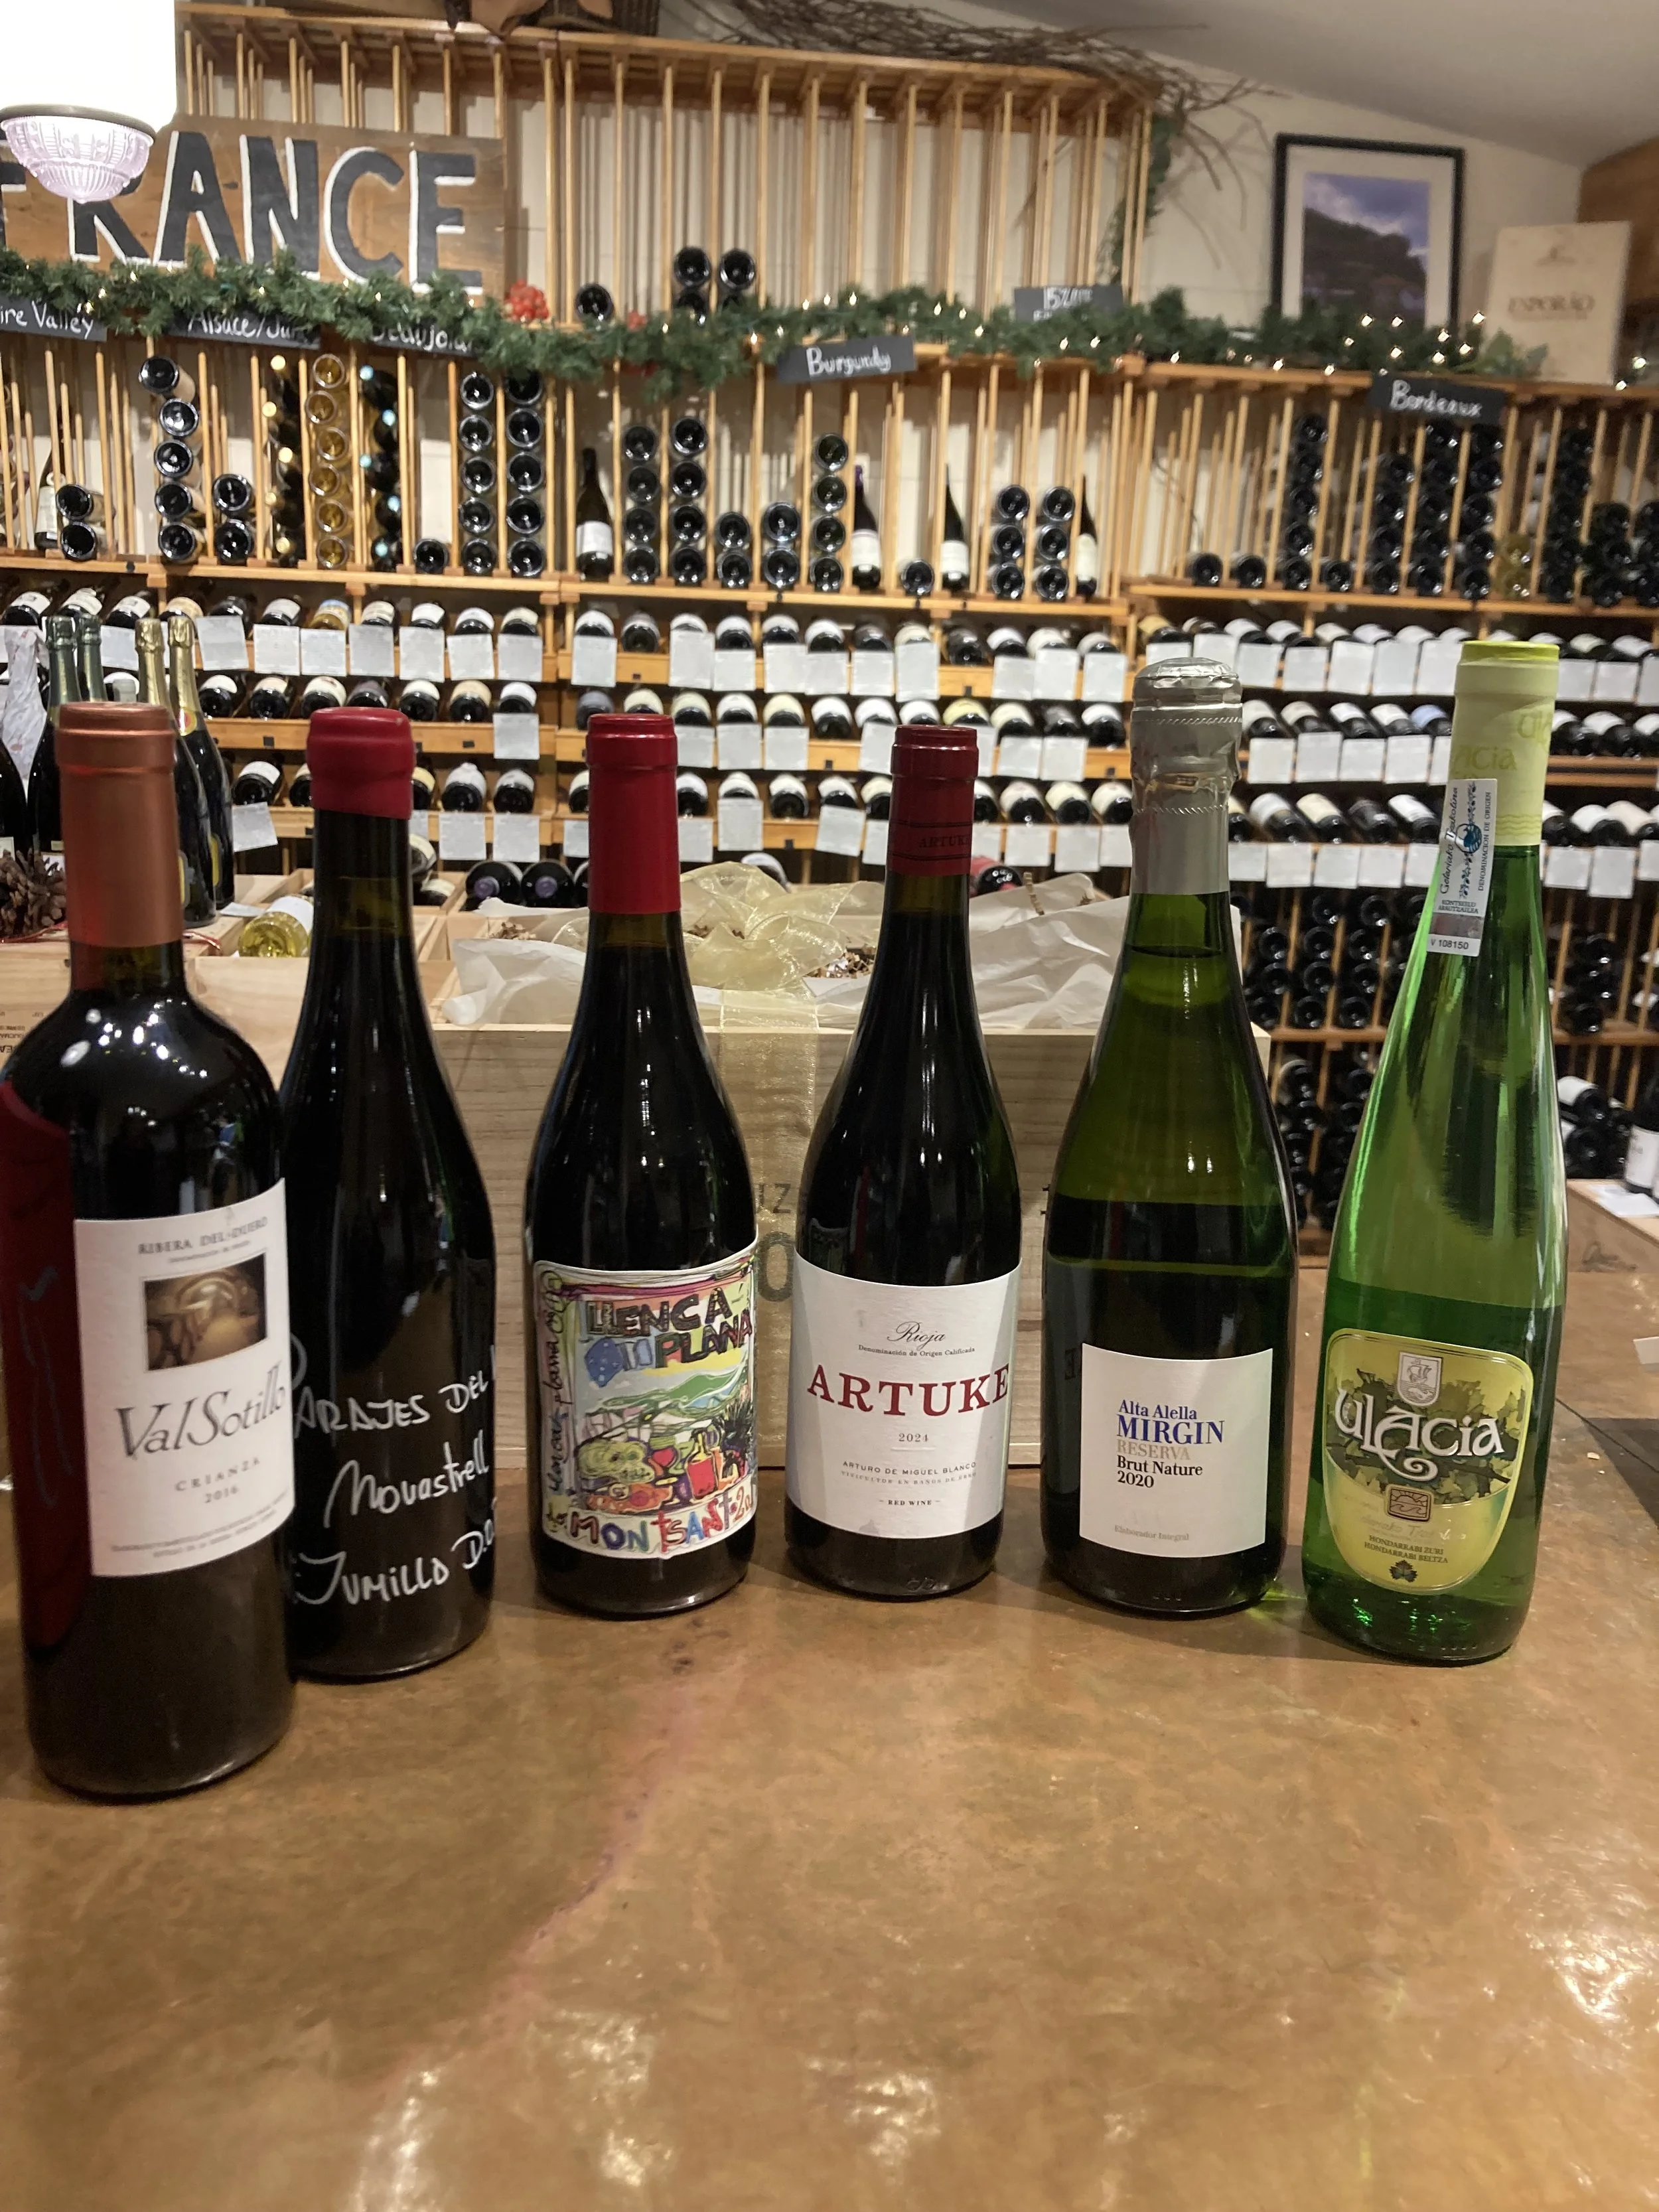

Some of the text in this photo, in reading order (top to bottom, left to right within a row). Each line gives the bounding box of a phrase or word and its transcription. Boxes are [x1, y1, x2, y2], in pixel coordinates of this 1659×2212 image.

[31, 300, 94, 340] Valley
[806, 345, 892, 378] Burgundy
[1390, 379, 1482, 417] Bordeaux
[1439, 939, 1469, 950] 108150
[655, 1307, 753, 1368] PLANA
[859, 1344, 907, 1357] Denominación
[944, 1347, 975, 1357] Calificada
[887, 1321, 946, 1351] Rioja
[807, 1363, 1010, 1417] ARTUKE
[1118, 1399, 1198, 1420] Alta Alella
[1116, 1414, 1225, 1445] MIRGIN
[1116, 1439, 1191, 1460] RESERVA
[175, 1457, 261, 1492] CRIANZA
[843, 1461, 881, 1474] ARTURO
[942, 1461, 977, 1474] BLANCO
[1116, 1454, 1203, 1476] Brut Nature
[1117, 1470, 1155, 1489] 2020
